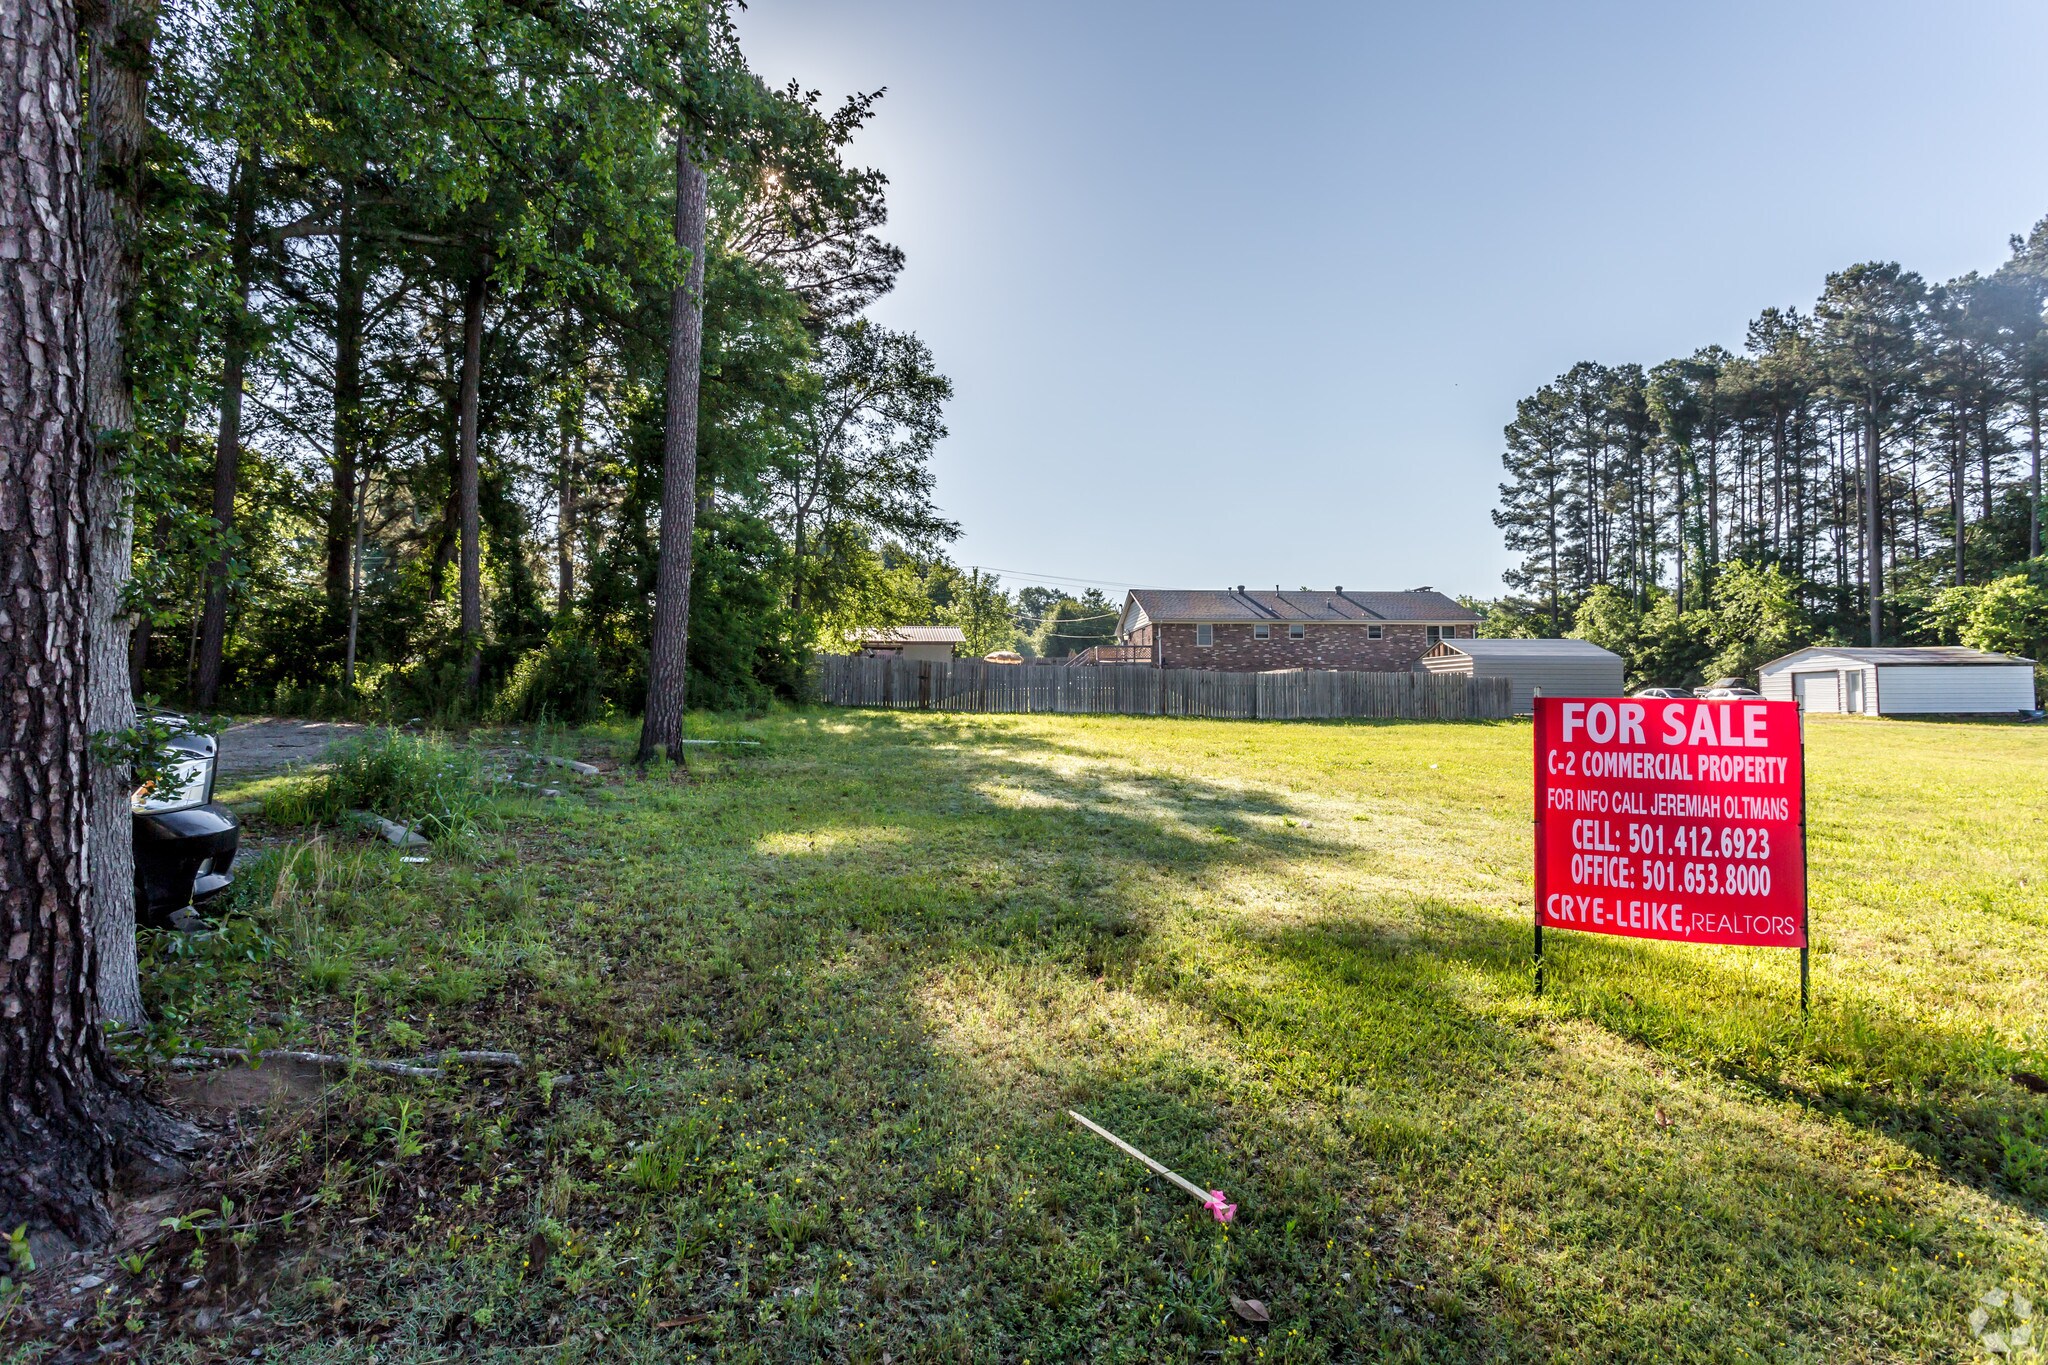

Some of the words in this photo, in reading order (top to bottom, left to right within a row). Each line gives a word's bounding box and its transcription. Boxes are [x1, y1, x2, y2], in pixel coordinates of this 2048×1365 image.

[1563, 703, 1646, 744] FOR
[1663, 704, 1768, 747] SALE
[1549, 750, 1575, 775] C-2
[1582, 751, 1692, 780] COMMERCIAL
[1698, 755, 1787, 783] PROPERTY
[1548, 788, 1573, 810] FOR
[1578, 790, 1608, 812] INFO
[1612, 792, 1647, 814] CALL
[1651, 794, 1720, 817] JEREMIAH
[1724, 796, 1788, 820] OLTMANS
[1572, 819, 1620, 852] CELL:
[1628, 824, 1770, 859] 501.412.6923
[1571, 854, 1635, 888] OFFICE:
[1643, 860, 1770, 896] 501.653.8000
[1546, 894, 1690, 936] CRYE-LEIKE,
[1692, 913, 1794, 935] REALTORS
